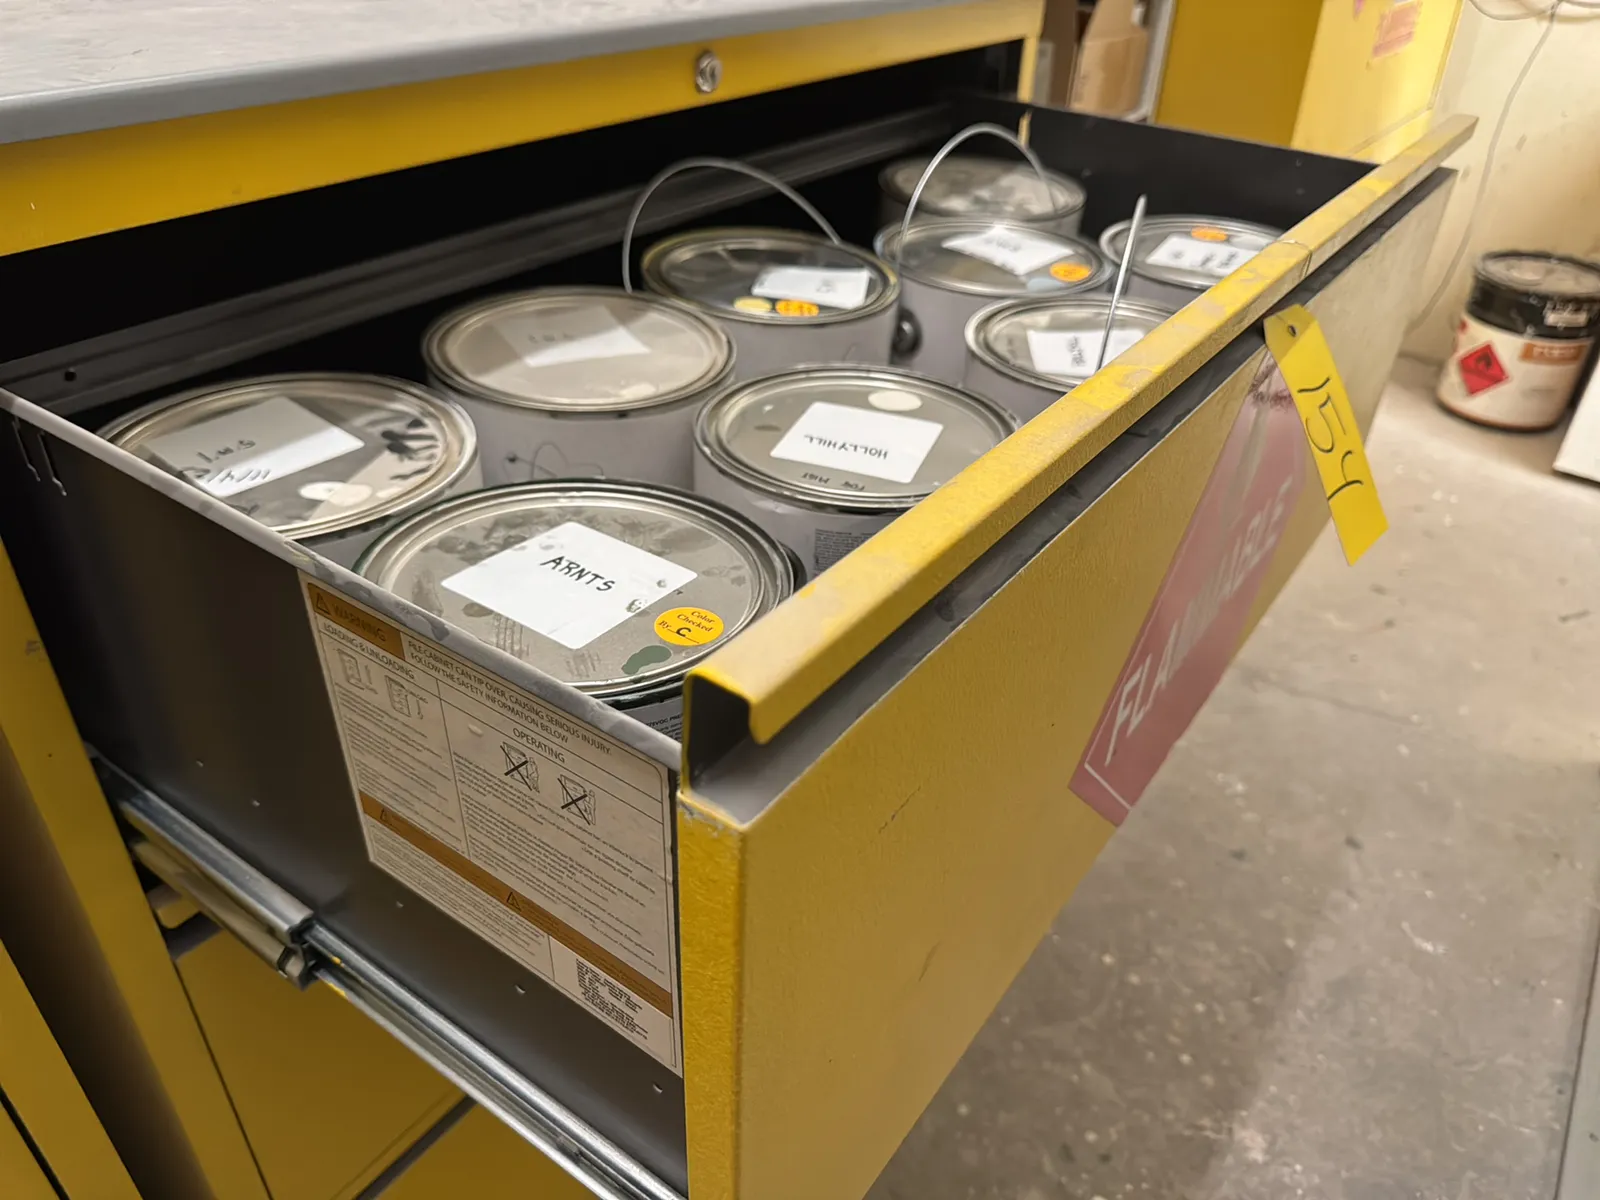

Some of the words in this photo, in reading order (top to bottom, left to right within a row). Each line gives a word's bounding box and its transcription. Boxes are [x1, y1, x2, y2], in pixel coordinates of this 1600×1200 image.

[1297, 376, 1364, 502] 154
[540, 555, 616, 592] ARNTS
[331, 603, 387, 642] WARNING
[658, 620, 672, 630] By
[676, 626, 692, 638] C
[676, 613, 715, 633] Checked
[691, 610, 716, 624] Color
[323, 621, 359, 648] LOADING
[366, 645, 415, 680] UNLOADING
[408, 640, 424, 655] FILE
[423, 650, 455, 670] CABINET
[456, 666, 472, 681] CAN
[472, 674, 485, 687] TIP
[508, 694, 545, 720] CAUSING
[545, 713, 580, 739] SERIOUS
[411, 653, 441, 675] FOLLOW
[441, 668, 457, 683] THE
[456, 677, 484, 697] SAFETY
[485, 692, 539, 728] INFORMATION
[540, 719, 569, 744] BELOW
[512, 727, 566, 764] OPERATING
